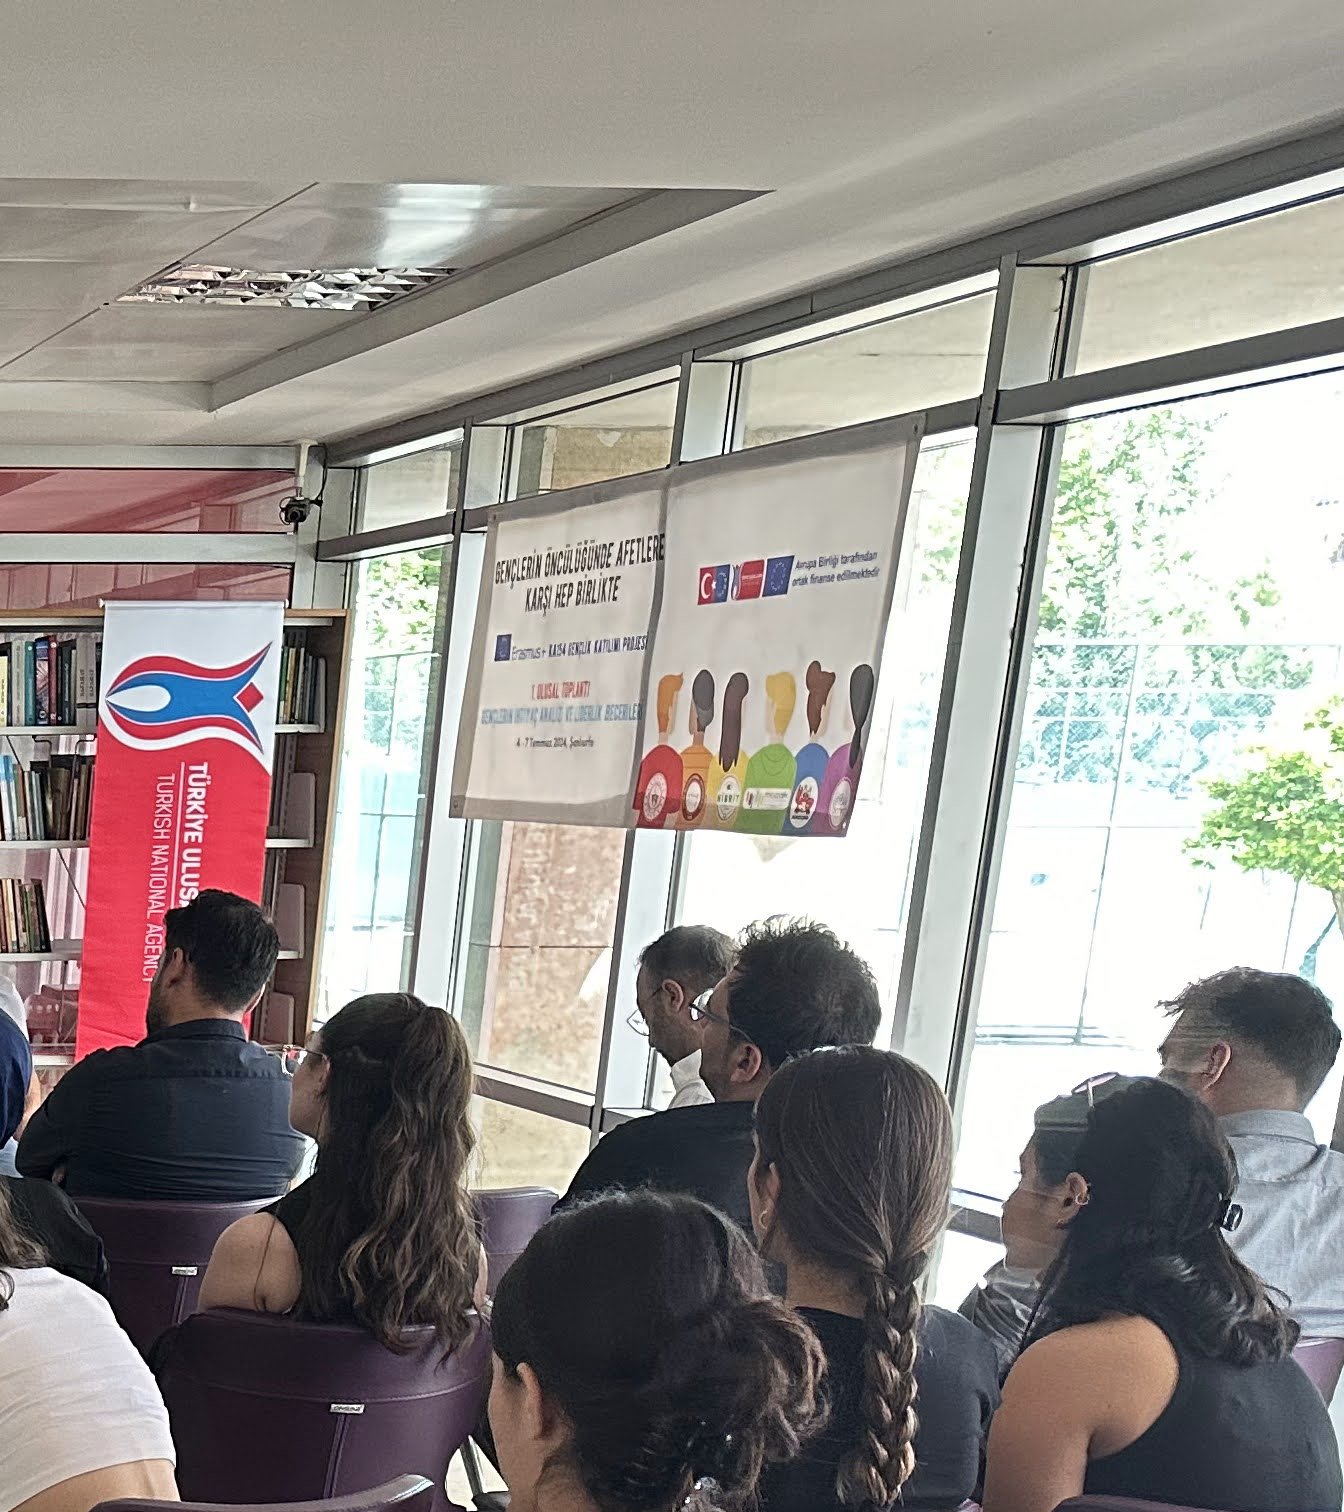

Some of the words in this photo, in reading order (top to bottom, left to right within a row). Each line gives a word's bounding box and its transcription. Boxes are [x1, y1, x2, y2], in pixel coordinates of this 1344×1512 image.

[495, 549, 543, 590] GENÇLERİN
[544, 540, 614, 578] ÖNCÜLÜĞÜNDE
[615, 533, 666, 567] AFETLERE
[525, 585, 553, 617] KARŞI
[554, 582, 574, 609] HEP
[575, 572, 622, 607] BİRLİKTE
[153, 773, 176, 840] TURKISH
[183, 762, 211, 844] TÜRKİYE
[146, 844, 170, 920] NATIONAL
